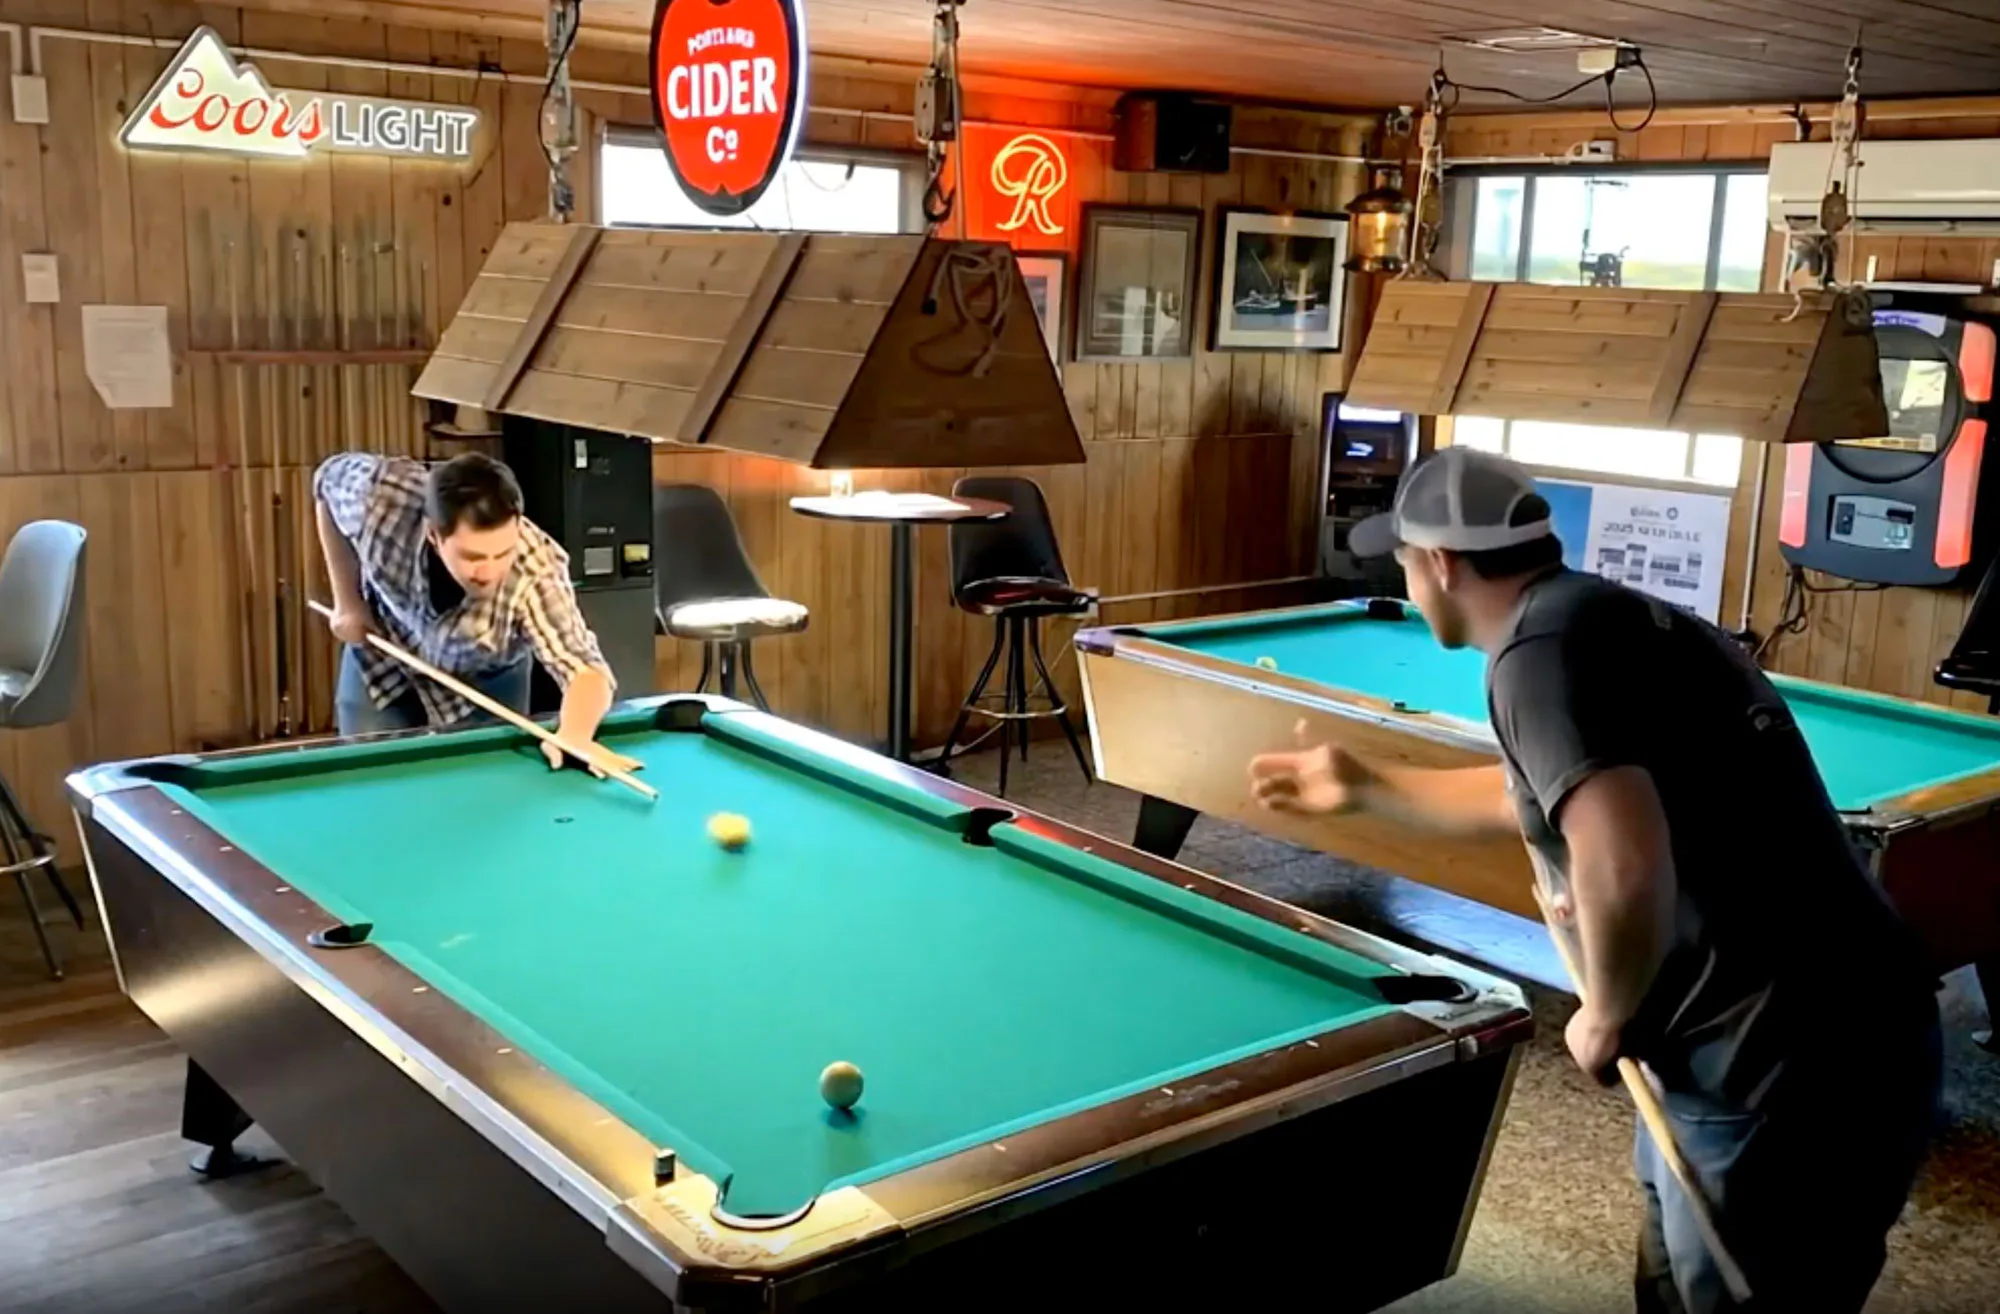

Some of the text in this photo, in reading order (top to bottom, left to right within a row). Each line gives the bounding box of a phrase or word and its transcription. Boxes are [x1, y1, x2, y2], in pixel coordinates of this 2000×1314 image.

[149, 67, 476, 154] Coors LIGHT
[667, 57, 779, 119] CIDER
[990, 133, 1068, 235] R
